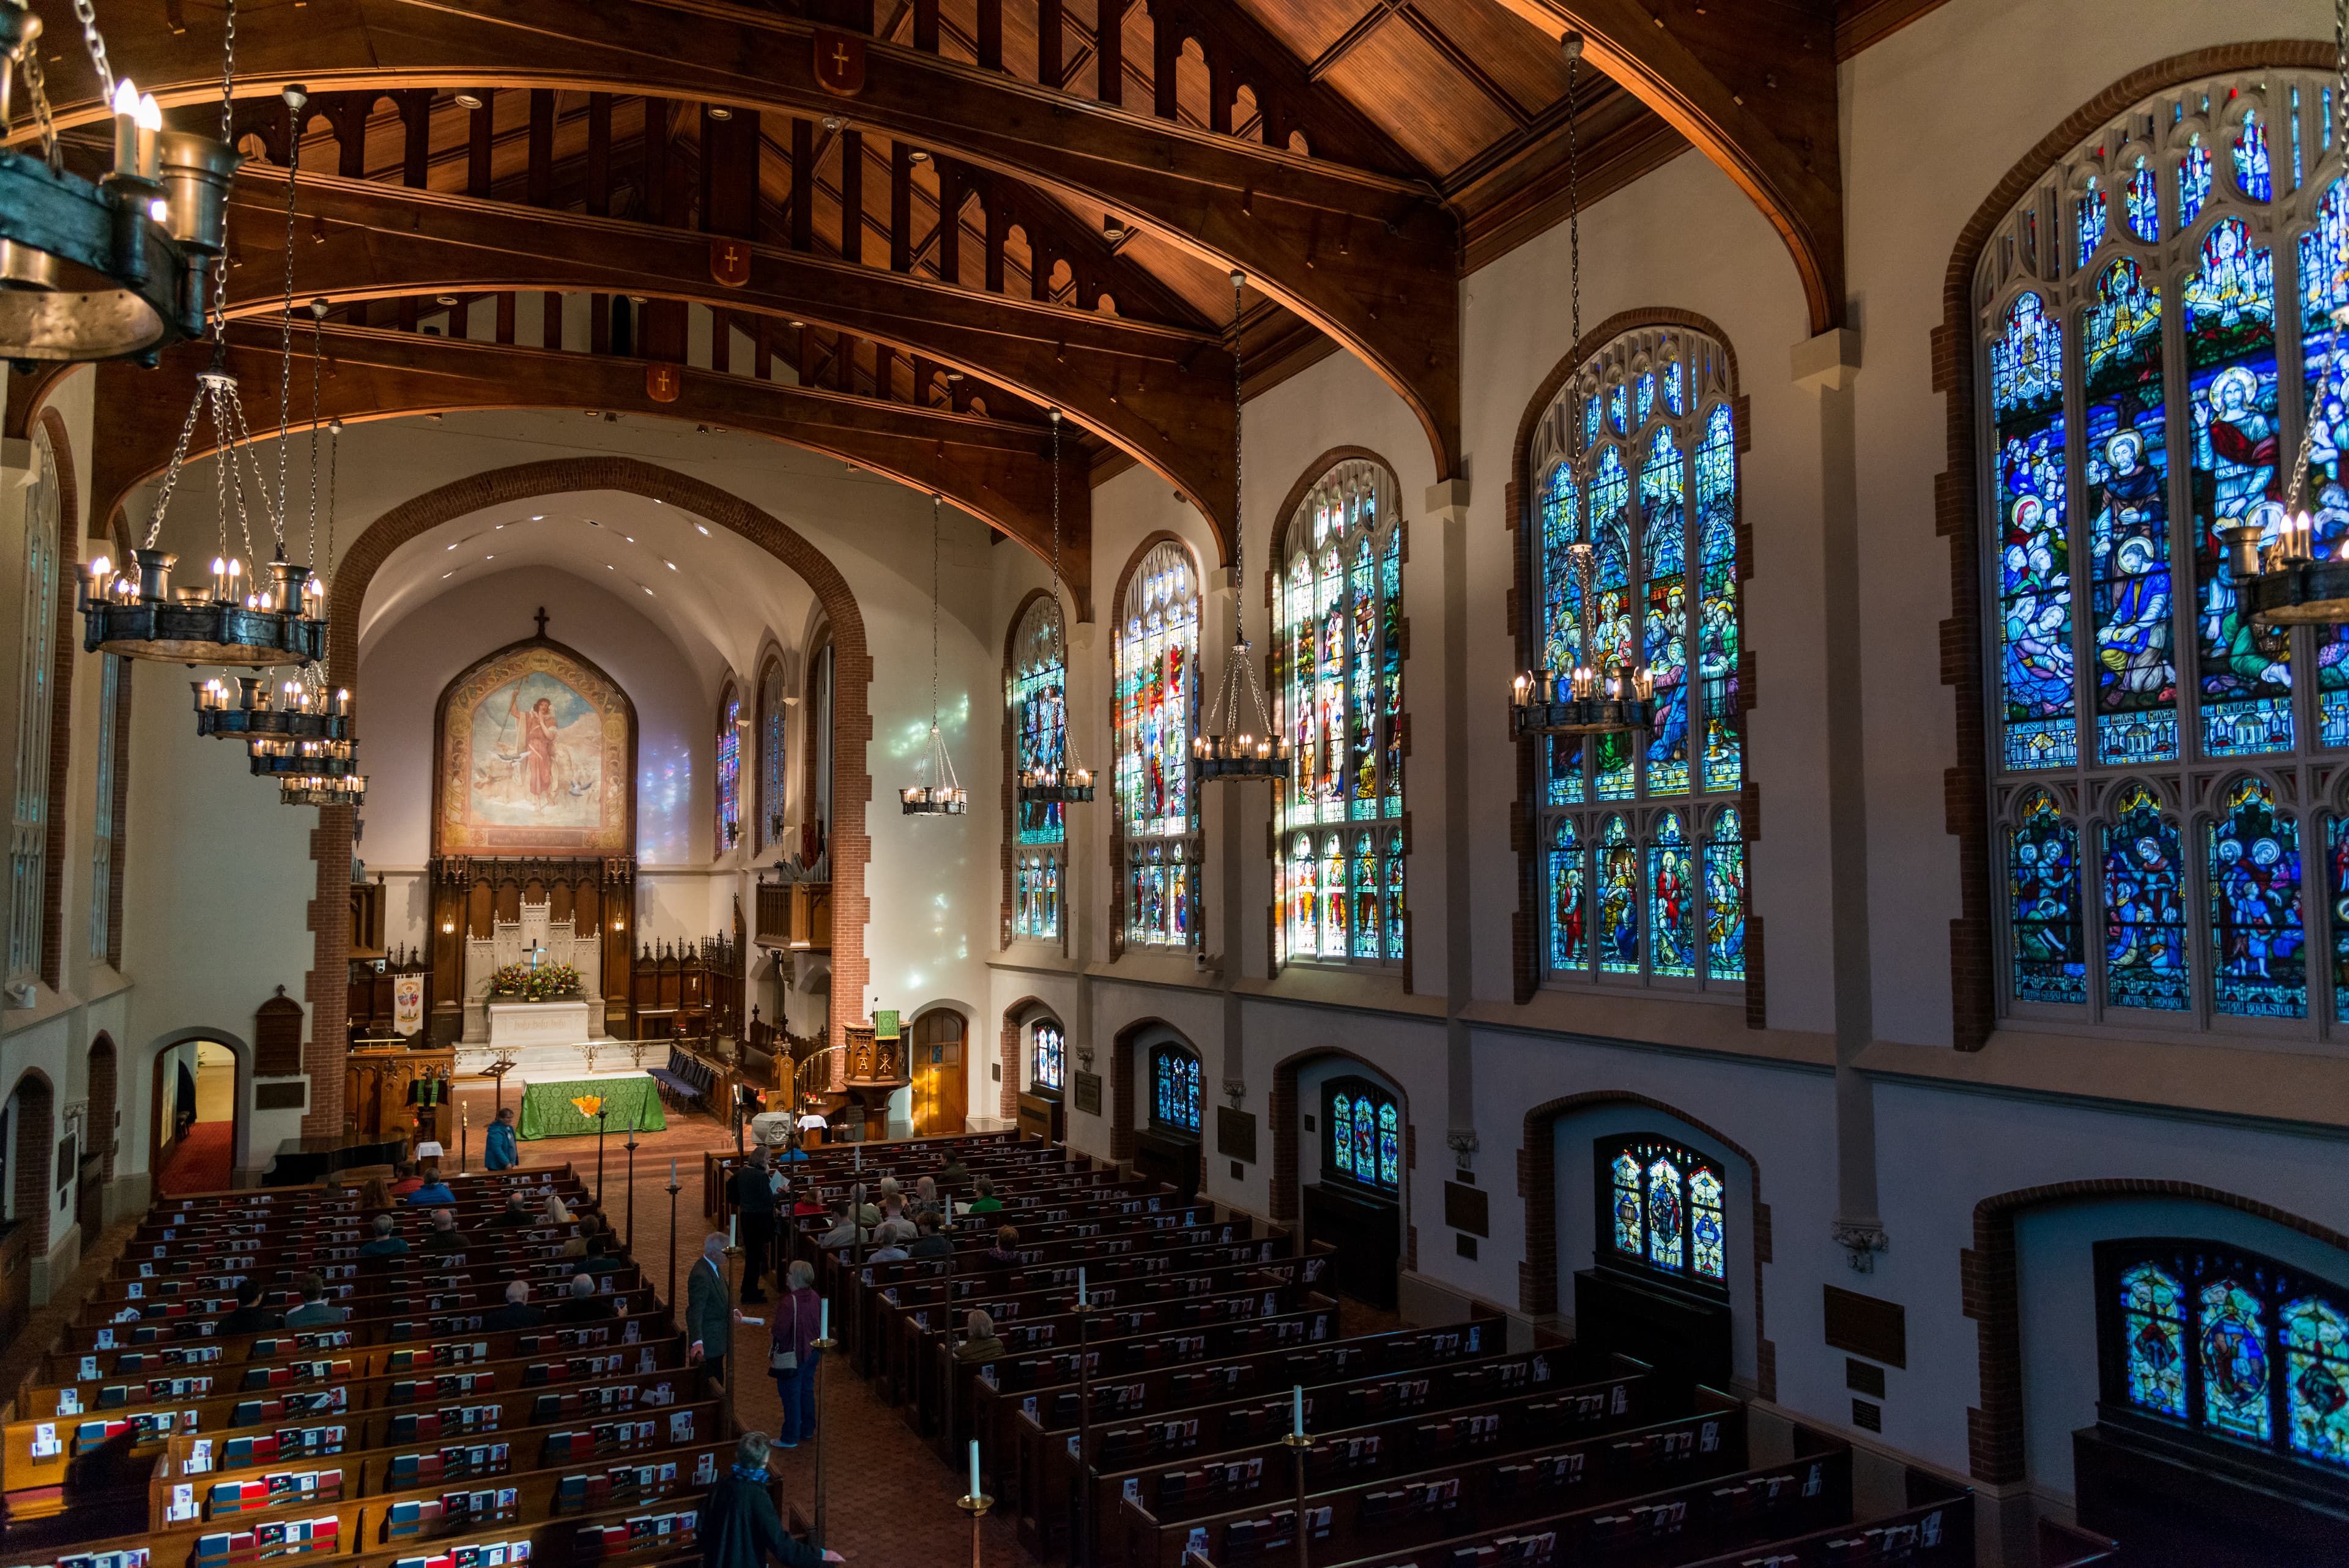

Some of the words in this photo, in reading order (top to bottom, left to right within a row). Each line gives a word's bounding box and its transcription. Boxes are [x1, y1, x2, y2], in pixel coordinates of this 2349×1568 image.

[2015, 721, 2044, 734] BLESSED
[2217, 702, 2256, 716] DISCIPLES
[2118, 994, 2146, 1006] LOVING
